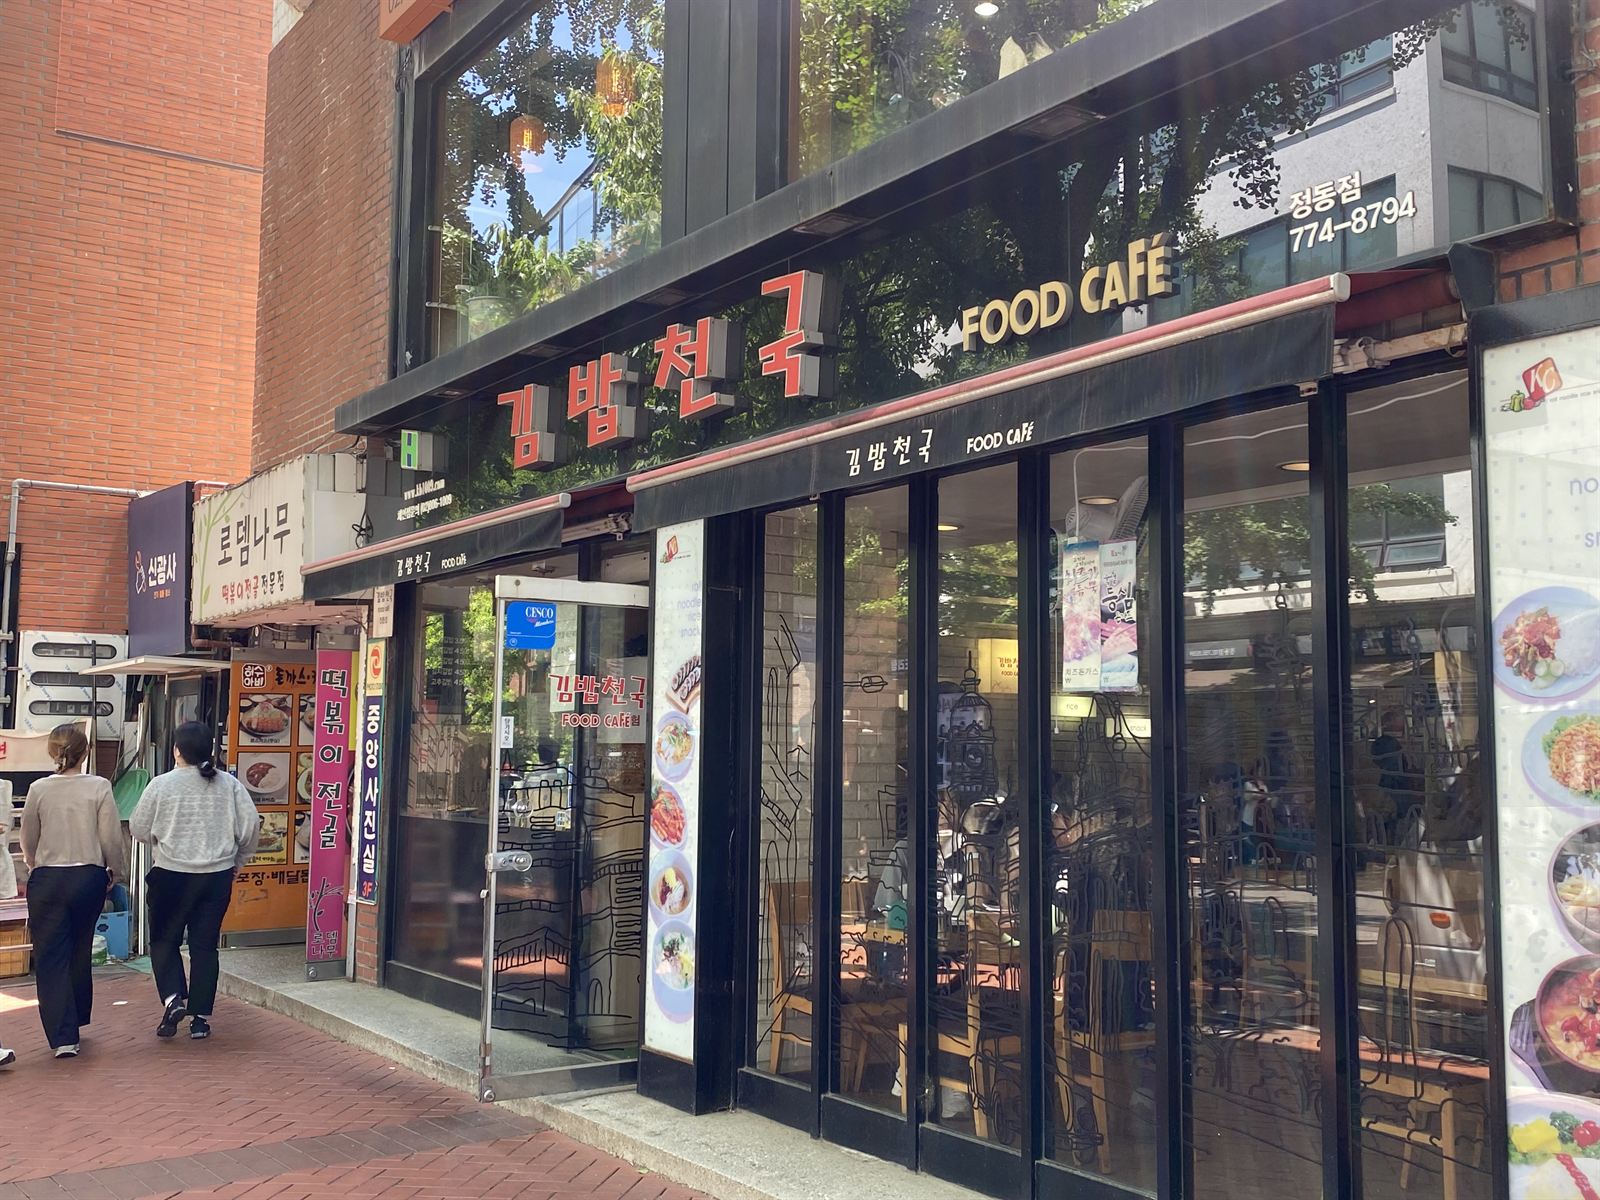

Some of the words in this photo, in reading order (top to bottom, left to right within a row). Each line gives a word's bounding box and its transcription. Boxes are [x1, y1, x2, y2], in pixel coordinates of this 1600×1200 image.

[1289, 170, 1361, 219] 정동점
[1289, 190, 1417, 253] 774-8794
[962, 281, 1070, 351] FOOD
[1080, 233, 1173, 314] CAFÉ
[497, 269, 808, 469] 김밥천국
[966, 433, 1003, 454] FOOD
[1006, 421, 1035, 446] CAFÉ
[846, 428, 934, 477] 김밥천국
[218, 503, 291, 567] 로뎀나무
[397, 552, 431, 577] 김밥천국
[441, 558, 456, 570] FOOD
[261, 570, 284, 595] 전문점
[525, 606, 554, 619] CESCO
[548, 674, 646, 709] 김밥천국
[561, 713, 600, 728] FOOD
[604, 711, 631, 728] CAFÉ
[361, 880, 374, 898] 3F
[312, 930, 338, 945] 로뎀
[312, 944, 338, 959] 나무
